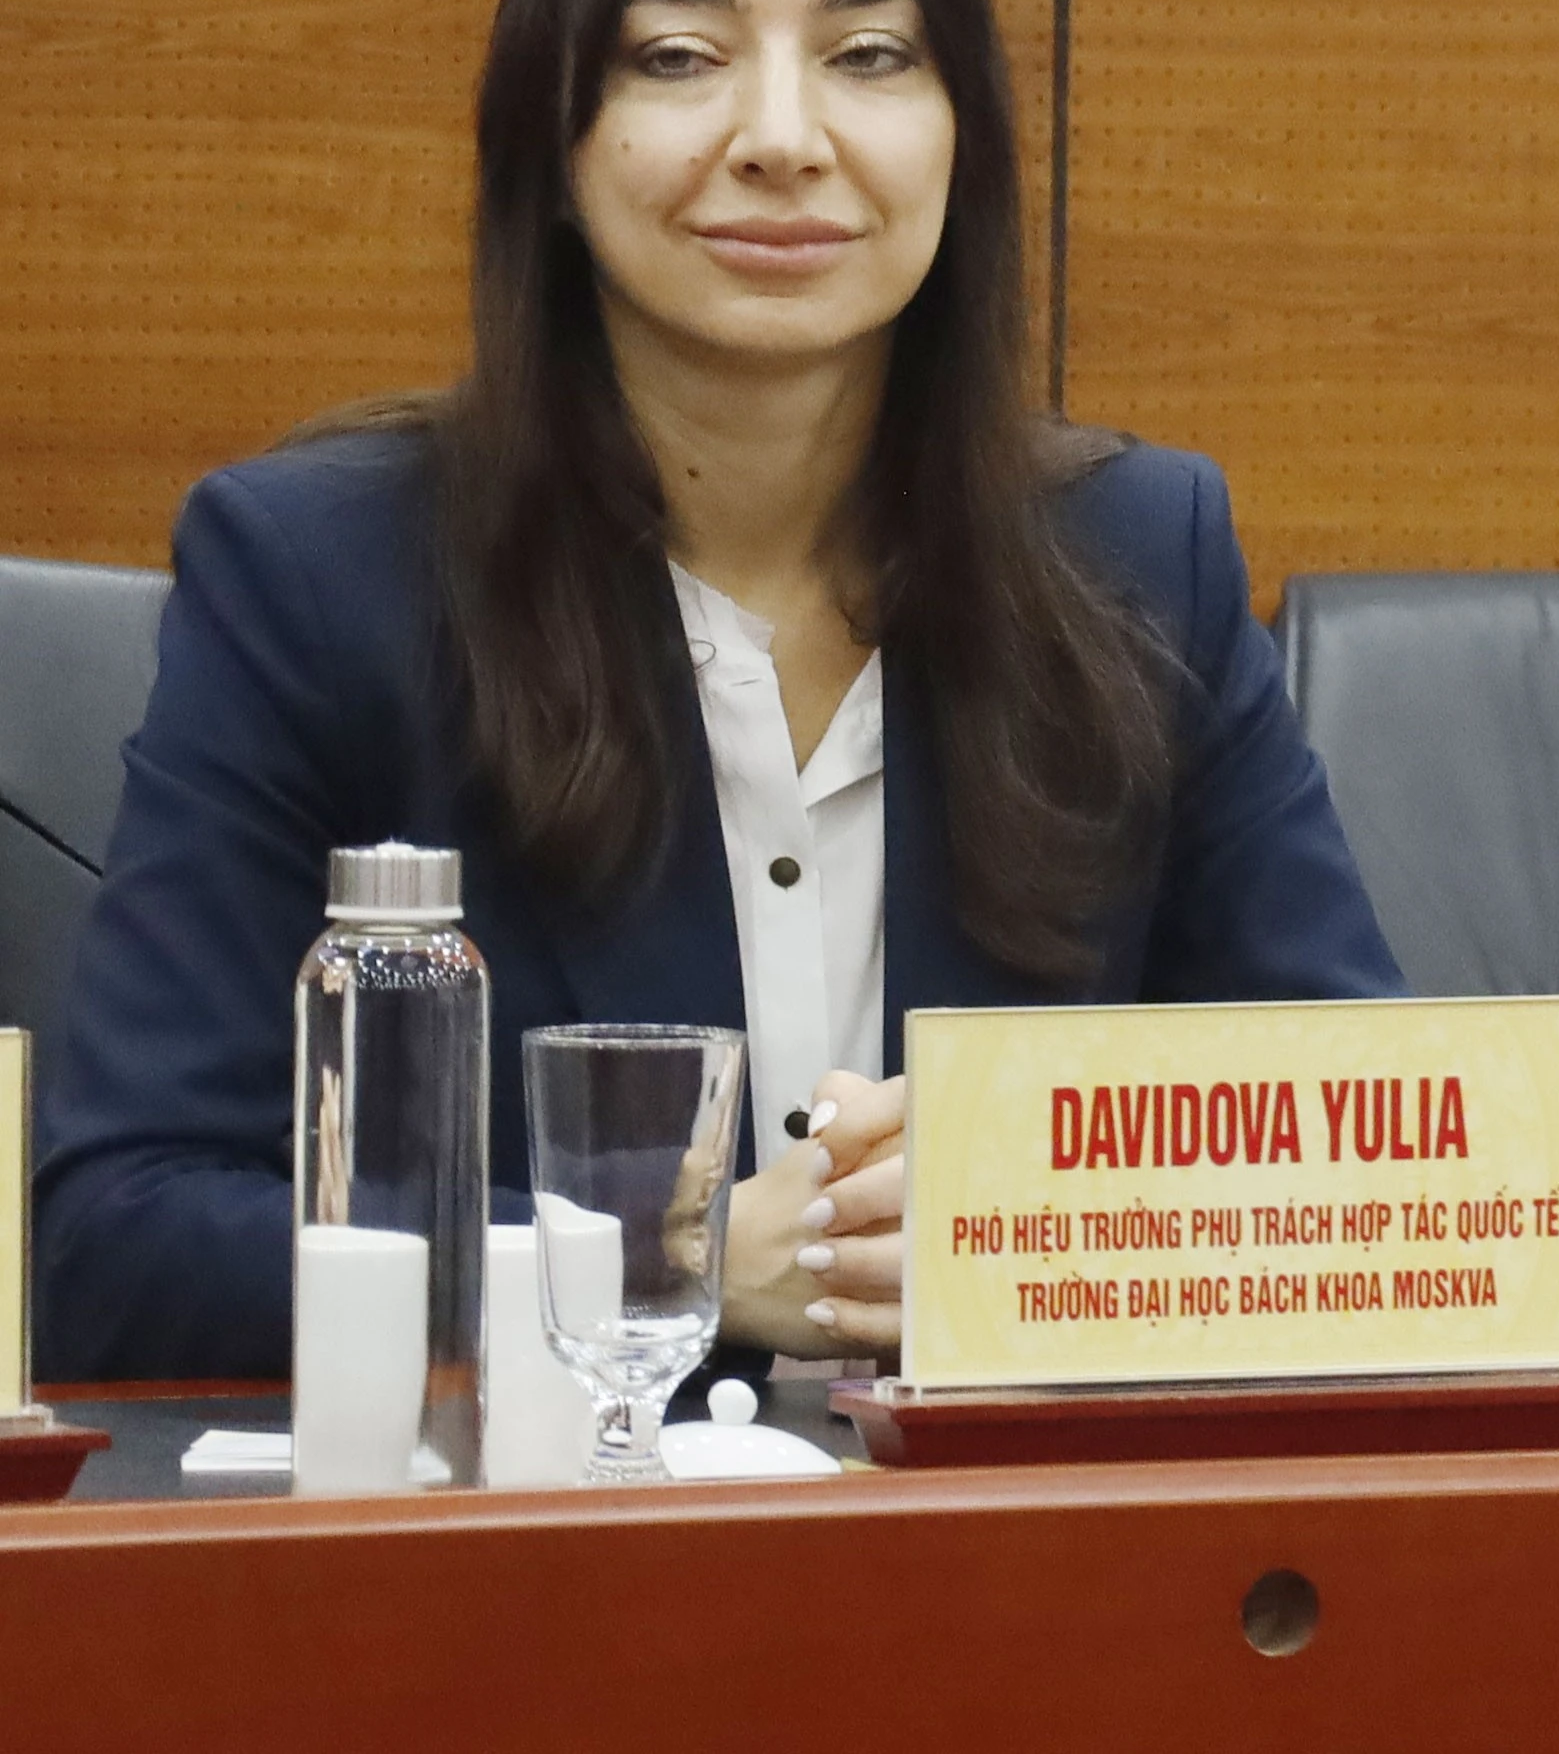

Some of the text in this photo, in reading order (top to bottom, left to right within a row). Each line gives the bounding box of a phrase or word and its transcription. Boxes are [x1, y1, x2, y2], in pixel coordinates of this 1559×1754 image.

[1050, 1076, 1469, 1171] DAVIDOVA YULIA
[952, 1206, 1004, 1256] PHÓ
[1012, 1203, 1071, 1262] HIỆU
[1080, 1197, 1182, 1251] TRƯỞNG
[1191, 1208, 1242, 1256] PHỤ
[1250, 1197, 1333, 1246] TRÁCH
[1341, 1199, 1392, 1252] HỢP
[1401, 1193, 1448, 1241] TÁC
[1456, 1185, 1524, 1244] QUỐC
[1016, 1266, 1497, 1327] TRƯỜNG ĐẠI HỌC BÁCH KHOA MOSKVA
